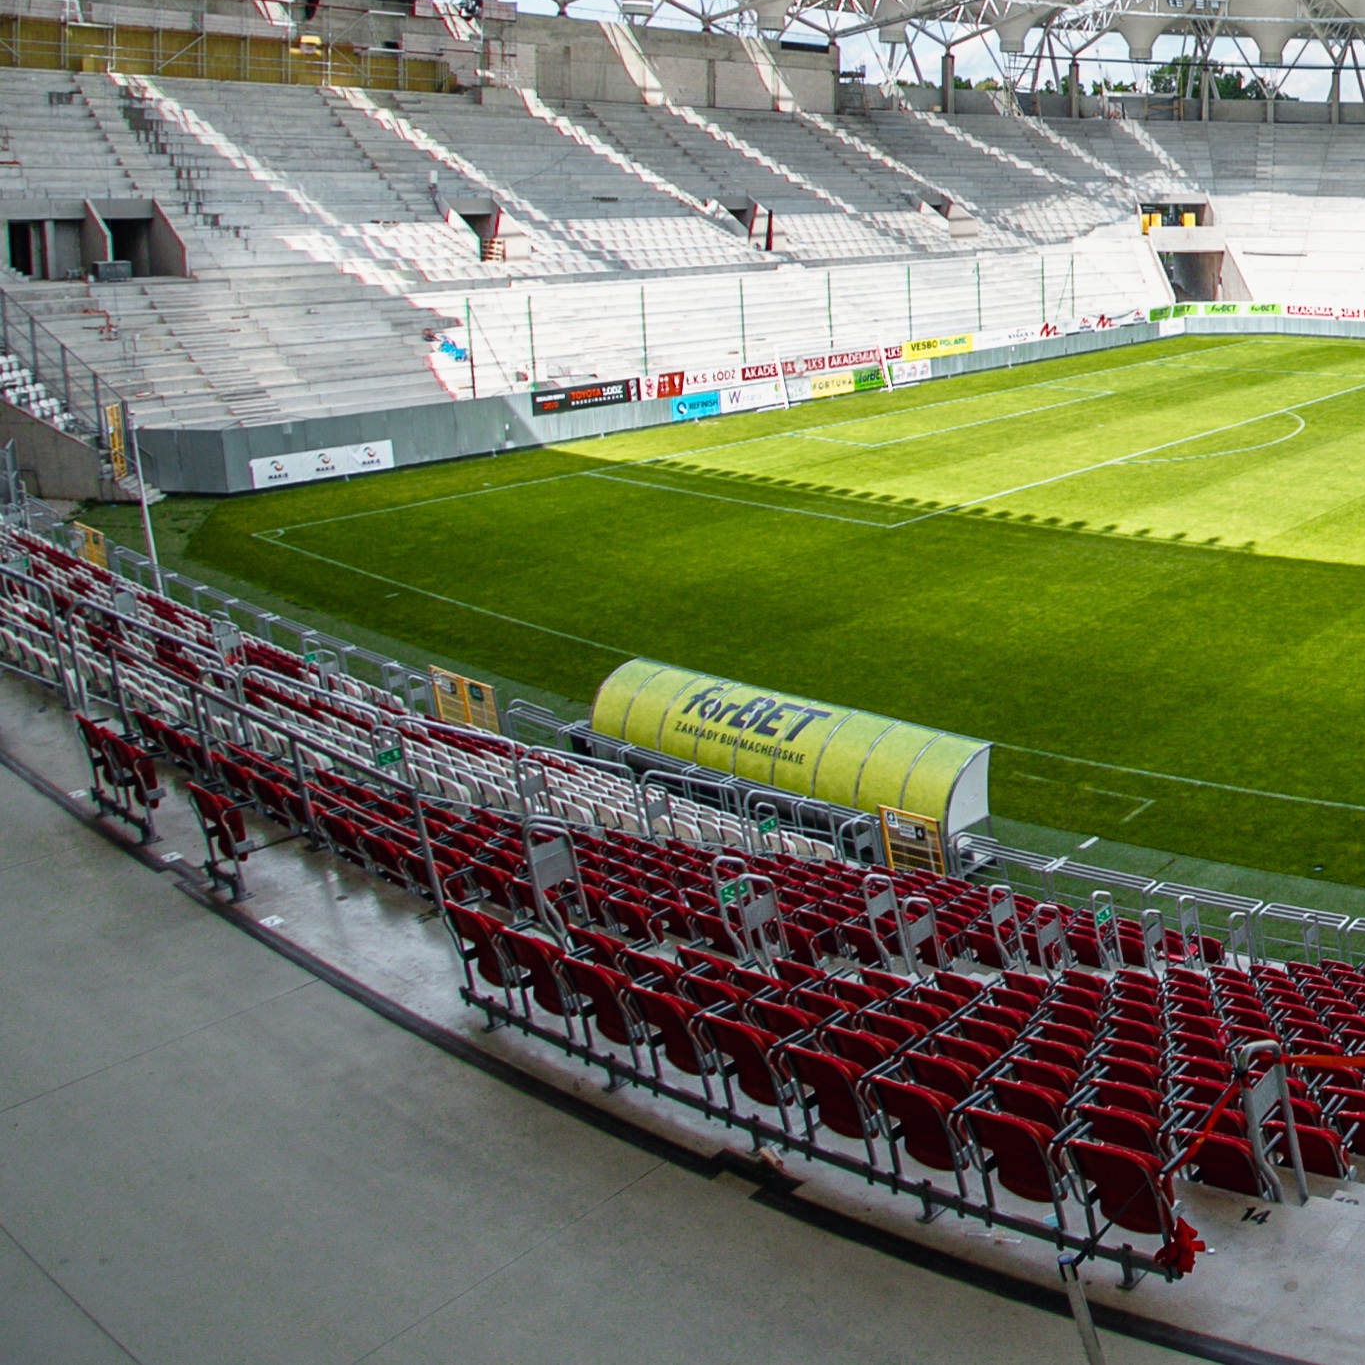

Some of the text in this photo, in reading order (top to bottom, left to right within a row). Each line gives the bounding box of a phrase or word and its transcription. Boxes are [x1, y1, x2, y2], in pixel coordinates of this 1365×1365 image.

[910, 339, 938, 351] VESBO
[830, 351, 876, 367] AKADEMIA
[814, 379, 854, 390] FORTUNA
[570, 387, 602, 400] TOYOTA
[689, 398, 719, 411] REFINISH
[682, 685, 833, 742] forBET
[674, 721, 808, 766] ZAKŁADY BUKMACHERSKIE
[1241, 1206, 1272, 1225] 14
